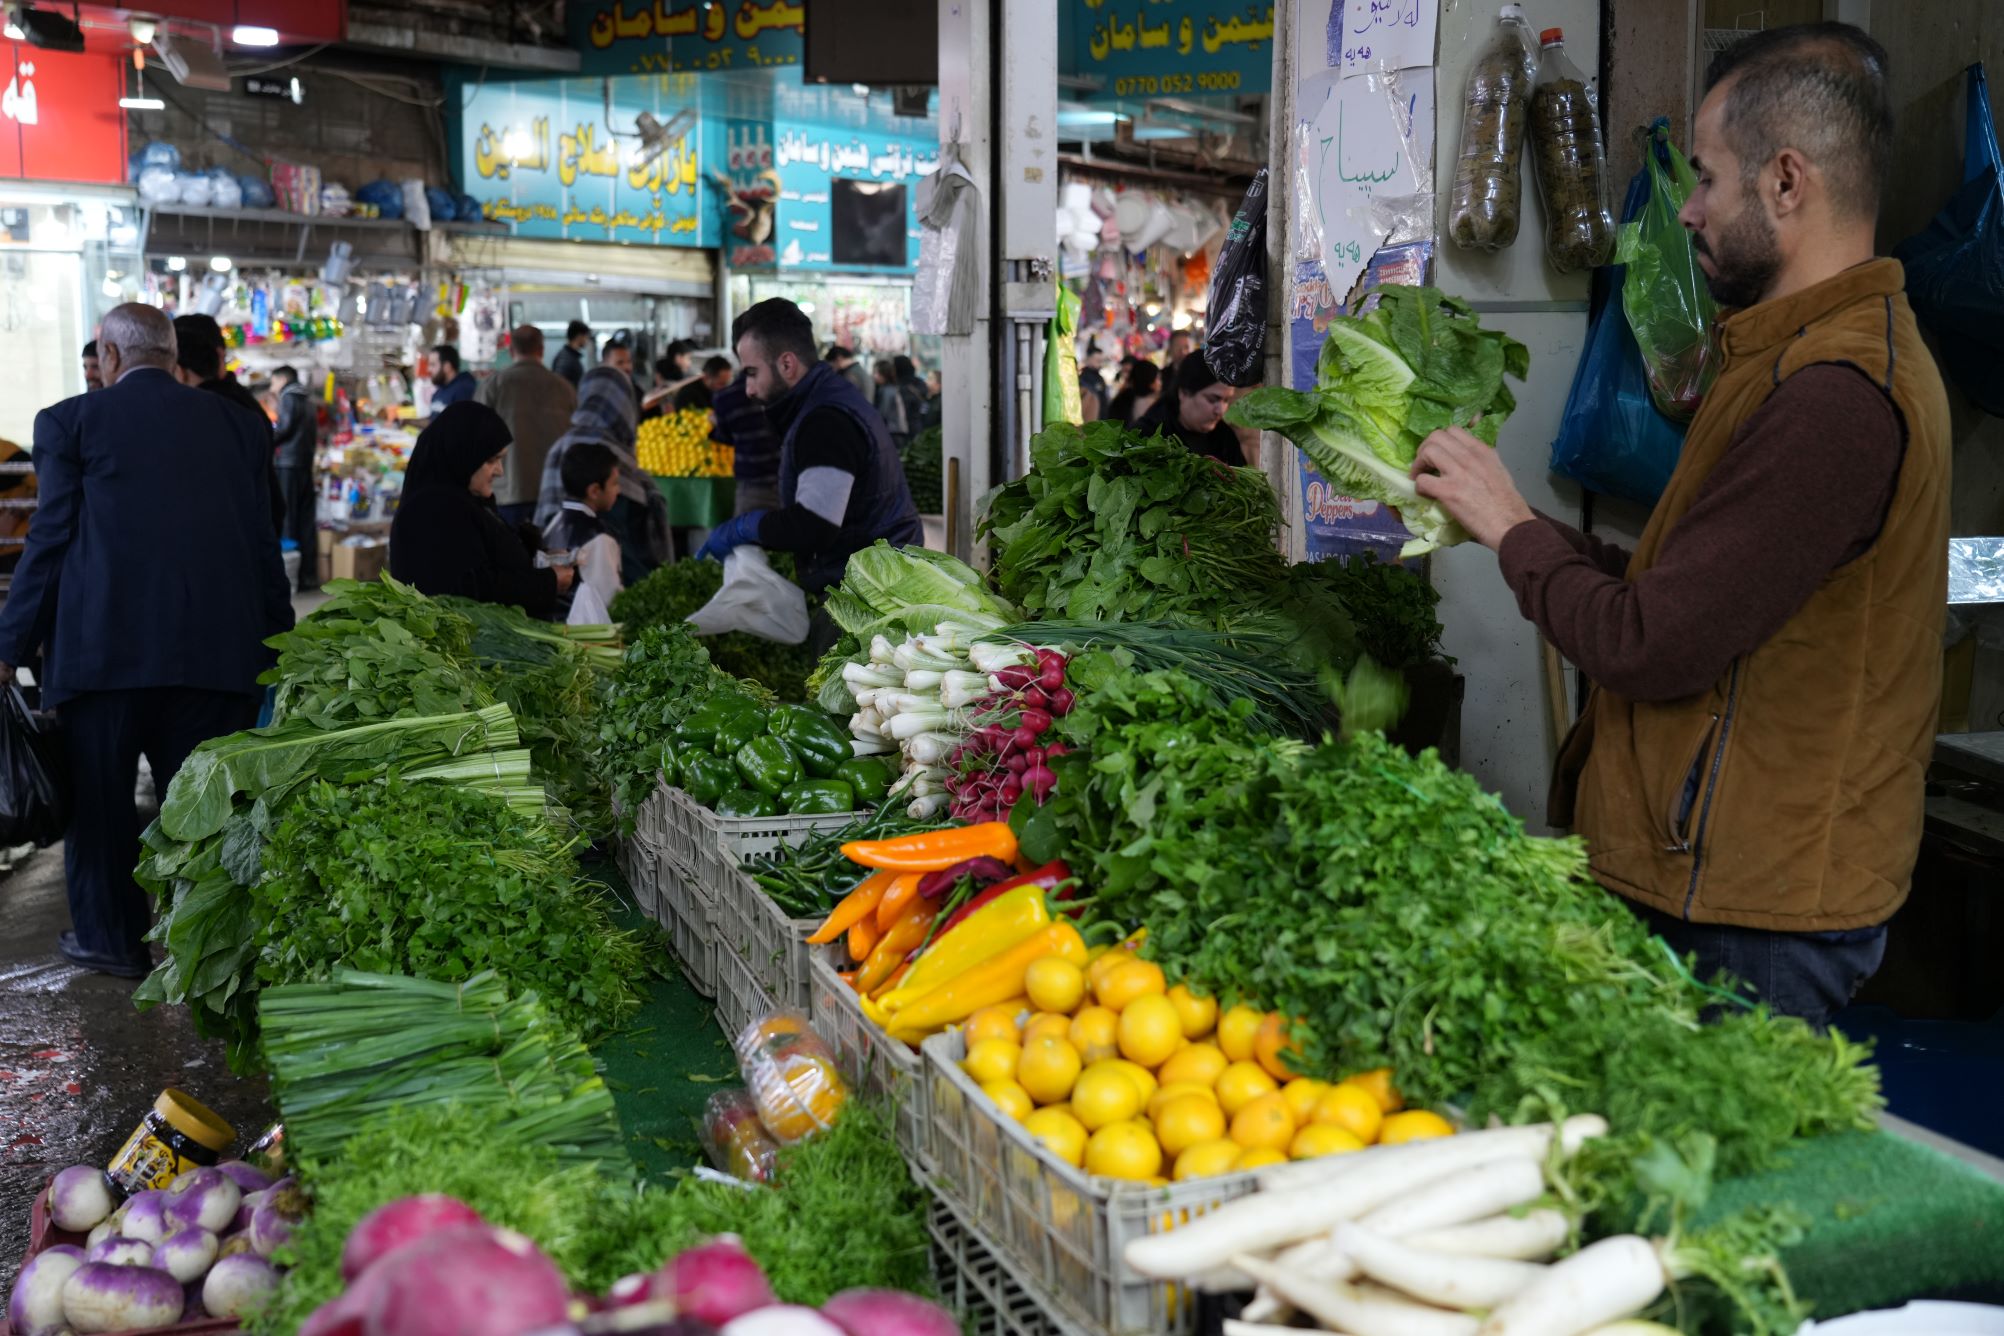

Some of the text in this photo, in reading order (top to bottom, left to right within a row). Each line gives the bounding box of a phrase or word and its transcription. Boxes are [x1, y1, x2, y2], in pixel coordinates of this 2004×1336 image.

[591, 0, 698, 48] سامان
[1090, 11, 1170, 61] سامان
[1177, 15, 1193, 56] و
[1115, 71, 1241, 96] 0770 052 9000
[475, 115, 548, 181] الین
[776, 129, 819, 167] سامان
[1305, 481, 1354, 524] Peppers
